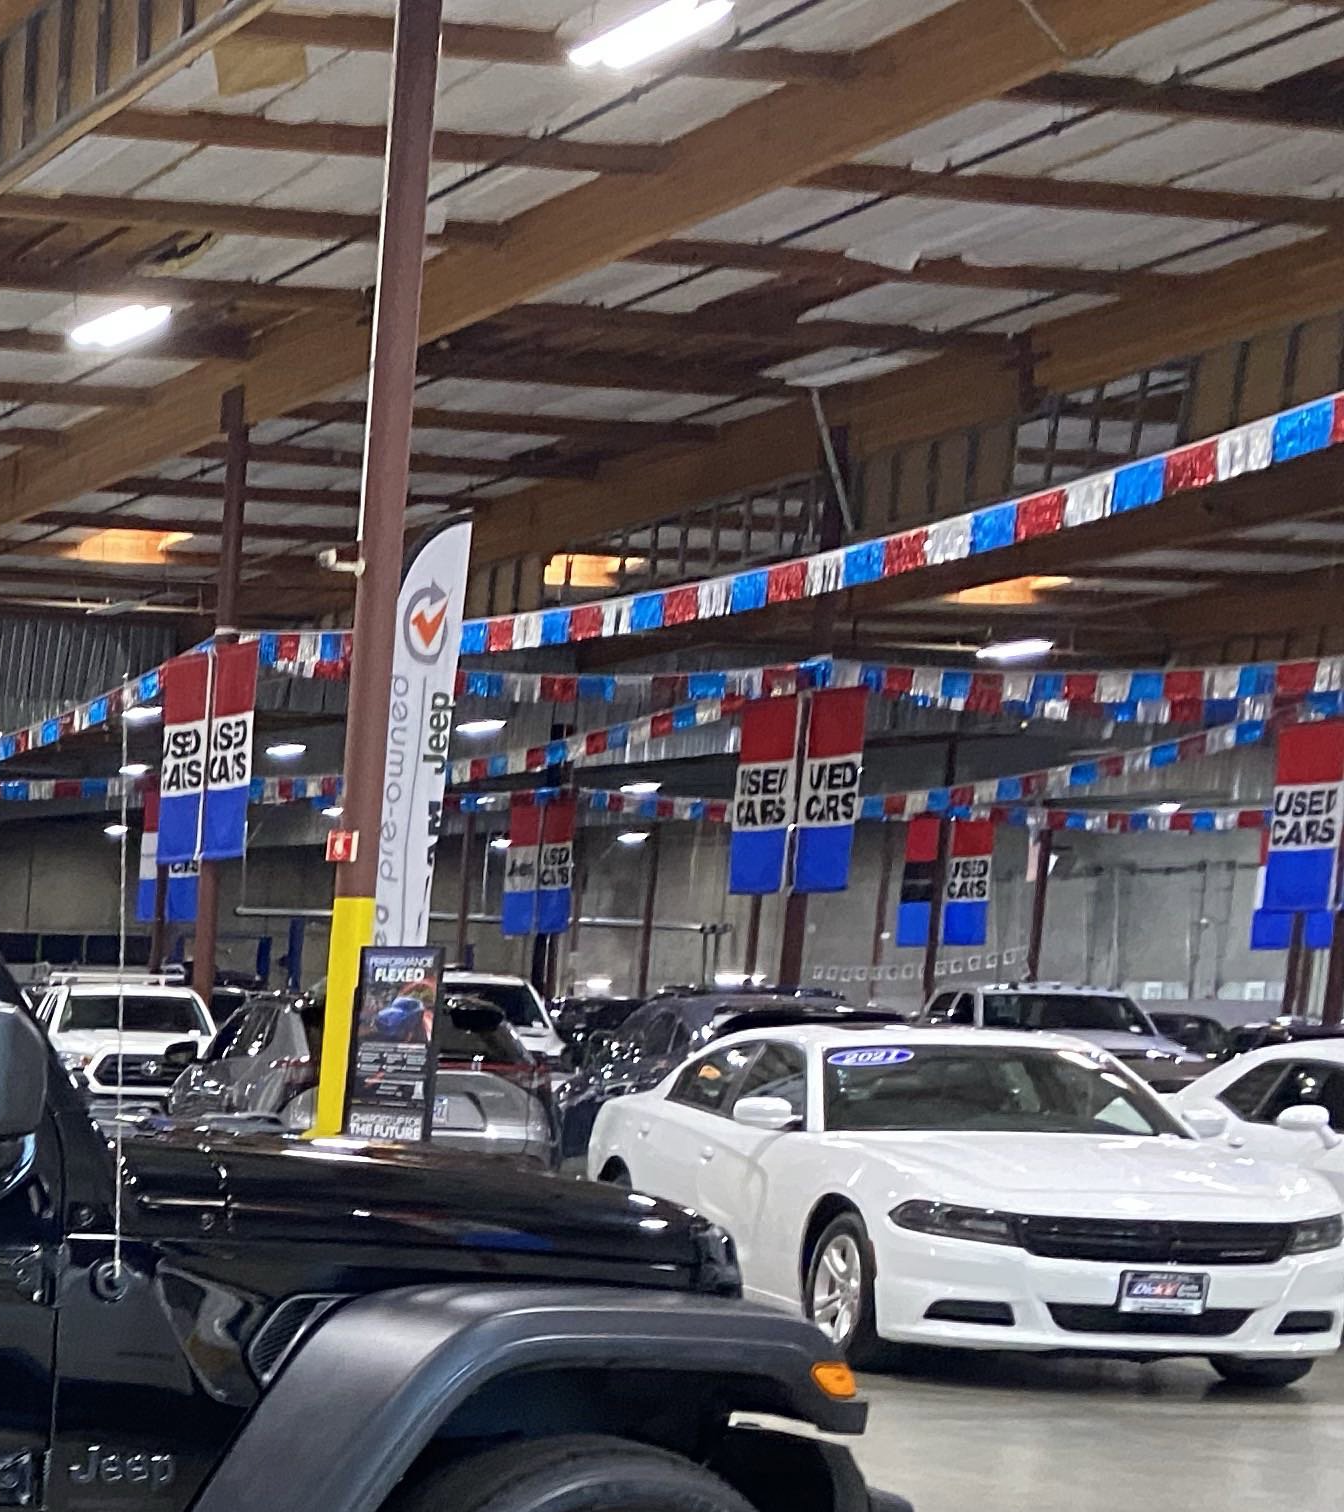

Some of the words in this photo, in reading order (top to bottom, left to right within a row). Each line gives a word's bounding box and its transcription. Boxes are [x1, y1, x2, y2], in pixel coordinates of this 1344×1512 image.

[422, 691, 456, 776] Jeep
[162, 760, 202, 792] AS
[379, 674, 409, 883] pre-owned
[810, 761, 858, 791] UED
[805, 792, 856, 821] CRS
[1274, 789, 1339, 817] USED
[1271, 818, 1335, 846] CARS
[375, 967, 426, 983] FLEXED
[842, 1048, 901, 1065] 2021
[350, 1122, 372, 1137] THE
[373, 1124, 422, 1141] FUTURE
[69, 1445, 176, 1489] Jeep
